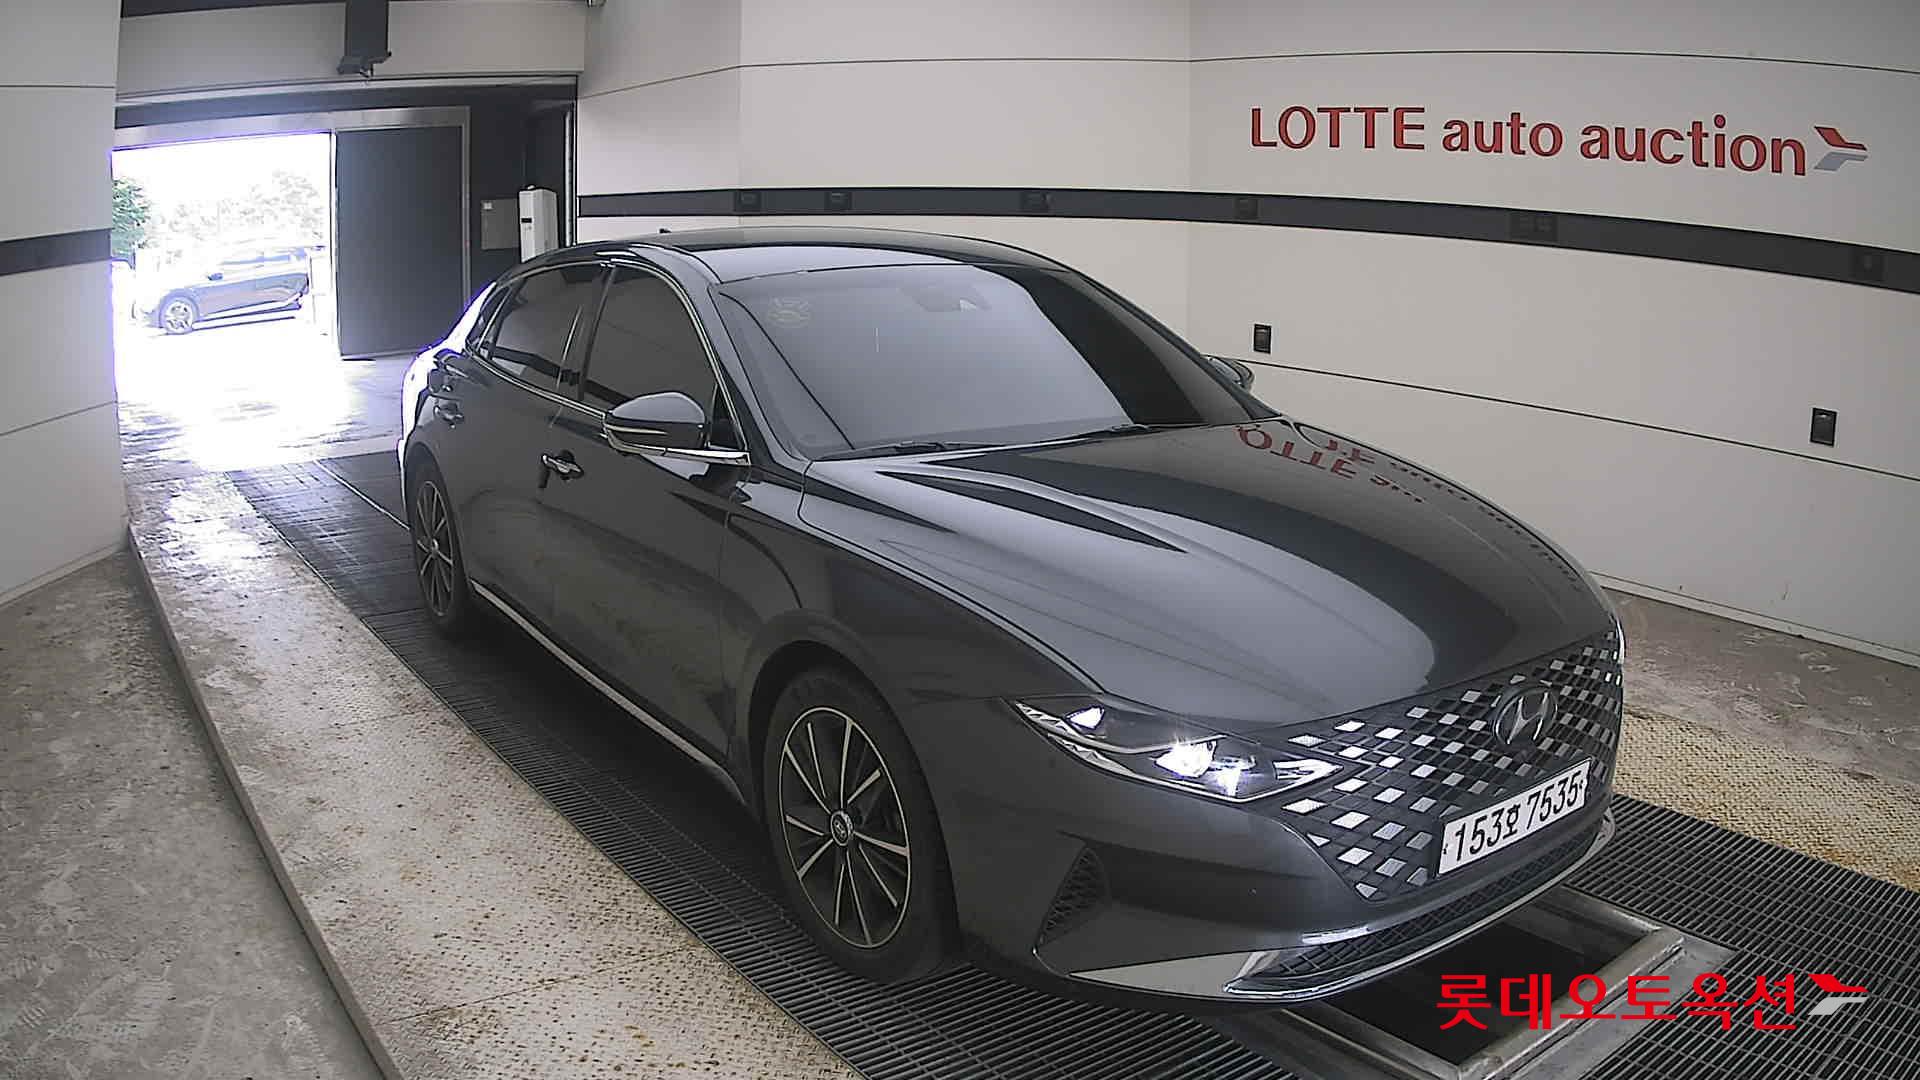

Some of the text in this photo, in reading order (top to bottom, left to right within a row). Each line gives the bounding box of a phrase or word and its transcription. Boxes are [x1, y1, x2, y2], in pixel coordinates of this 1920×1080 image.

[1250, 105, 1807, 177] LOTTE auto auction
[1525, 769, 1583, 831] 7535
